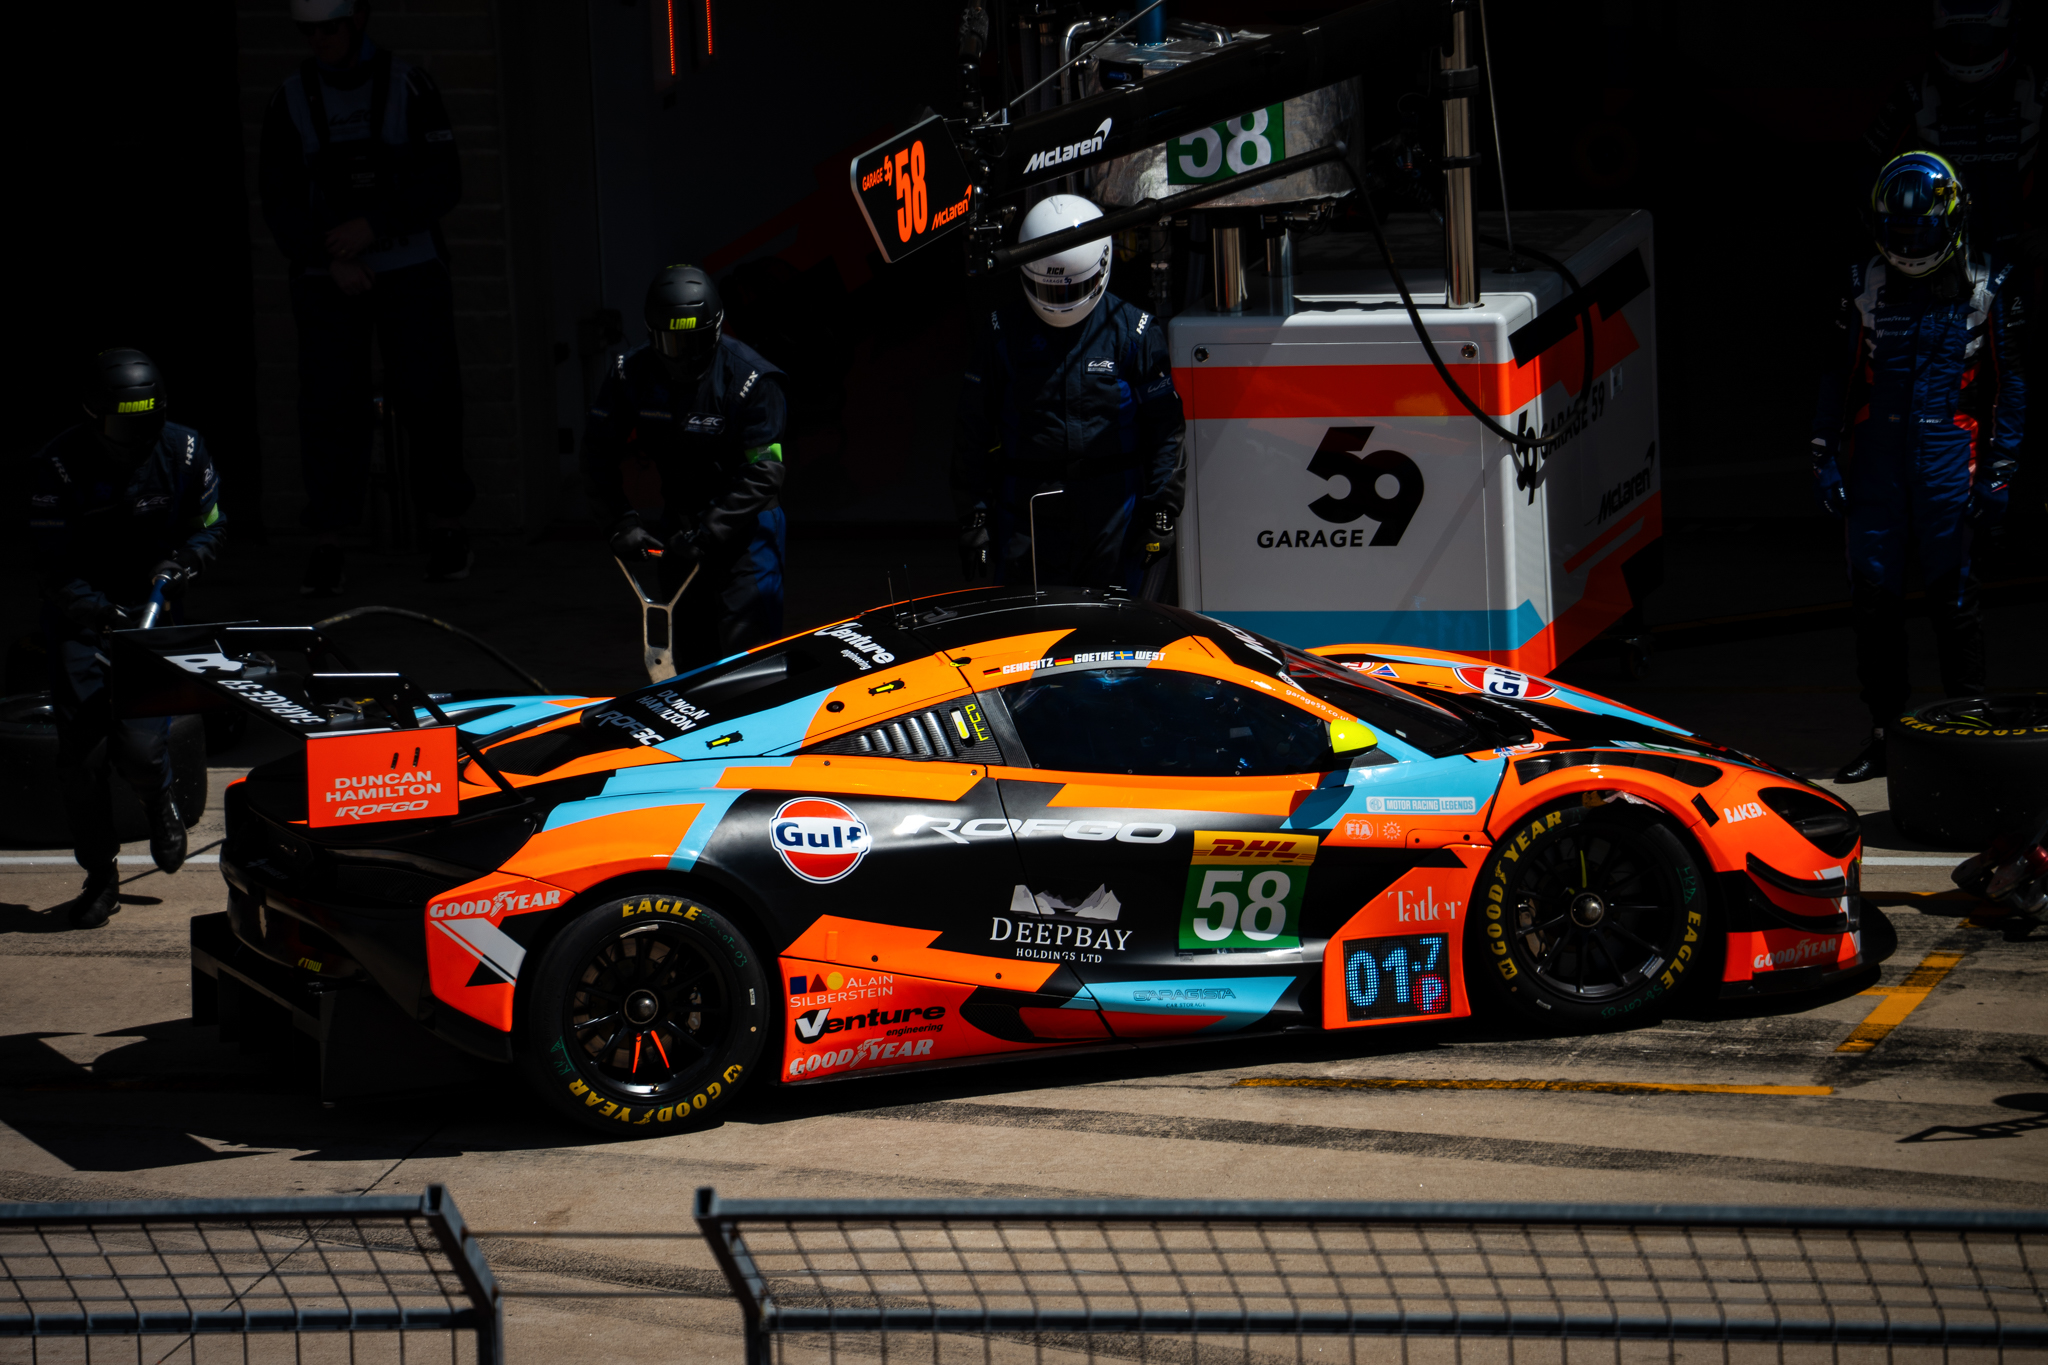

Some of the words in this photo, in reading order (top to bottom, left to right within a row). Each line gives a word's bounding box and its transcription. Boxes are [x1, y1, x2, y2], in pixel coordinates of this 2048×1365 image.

[1023, 127, 1107, 174] McLaren
[1179, 108, 1272, 178] 58
[862, 166, 884, 192] GARAGE
[894, 140, 928, 243] 58
[931, 192, 970, 232] McLaren
[1046, 266, 1065, 275] RICH
[669, 316, 697, 330] LIAM
[1135, 311, 1150, 336] HRX
[1088, 360, 1115, 369] WEC
[739, 370, 758, 398] HRX
[1147, 377, 1171, 394] WEC
[1592, 380, 1605, 422] 59
[689, 416, 723, 427] WEC
[184, 434, 196, 466] HRX
[1307, 426, 1425, 546] 59
[1598, 460, 1653, 525] McLaren
[136, 496, 171, 508] WEC
[1257, 530, 1364, 548] GARAGE
[1002, 657, 1055, 675] GEHRSITZ
[1074, 650, 1115, 664] GOETHE
[1134, 650, 1167, 662] WEST
[217, 679, 264, 690] 59
[238, 690, 327, 725] GARAGE
[635, 694, 698, 732] HAMILTON
[656, 689, 710, 721] DUNCAN
[964, 703, 990, 742] PULL
[326, 782, 442, 803] HAMILTON
[335, 770, 432, 790] DUNCAN
[1386, 799, 1412, 810] MOTOR
[1412, 799, 1439, 811] RACING
[1441, 799, 1474, 811] LEGENDS
[775, 820, 866, 849] Gulf
[1209, 839, 1300, 859] DHL
[1486, 810, 1563, 957] GOODYEAR
[429, 890, 562, 919] GOODYEAR
[621, 897, 703, 922] EAGLE
[1192, 870, 1292, 941] 58
[1387, 886, 1462, 922] Tatler
[989, 916, 1133, 951] DEEPBAY
[1015, 947, 1076, 961] HOLDINGS
[1080, 953, 1103, 964] LTD
[1660, 910, 1702, 990] EAGLE
[1753, 937, 1837, 969] GOODYEAR
[846, 975, 894, 989] ALAIN
[1132, 987, 1237, 1002] GARAGISTA
[1421, 976, 1443, 1011] P
[790, 986, 894, 1008] SILBERSTEIN
[795, 1006, 946, 1042] Venture
[886, 1023, 943, 1037] engineering
[789, 1037, 935, 1076] GOODYEAR
[568, 1078, 722, 1126] GOODYEAR
